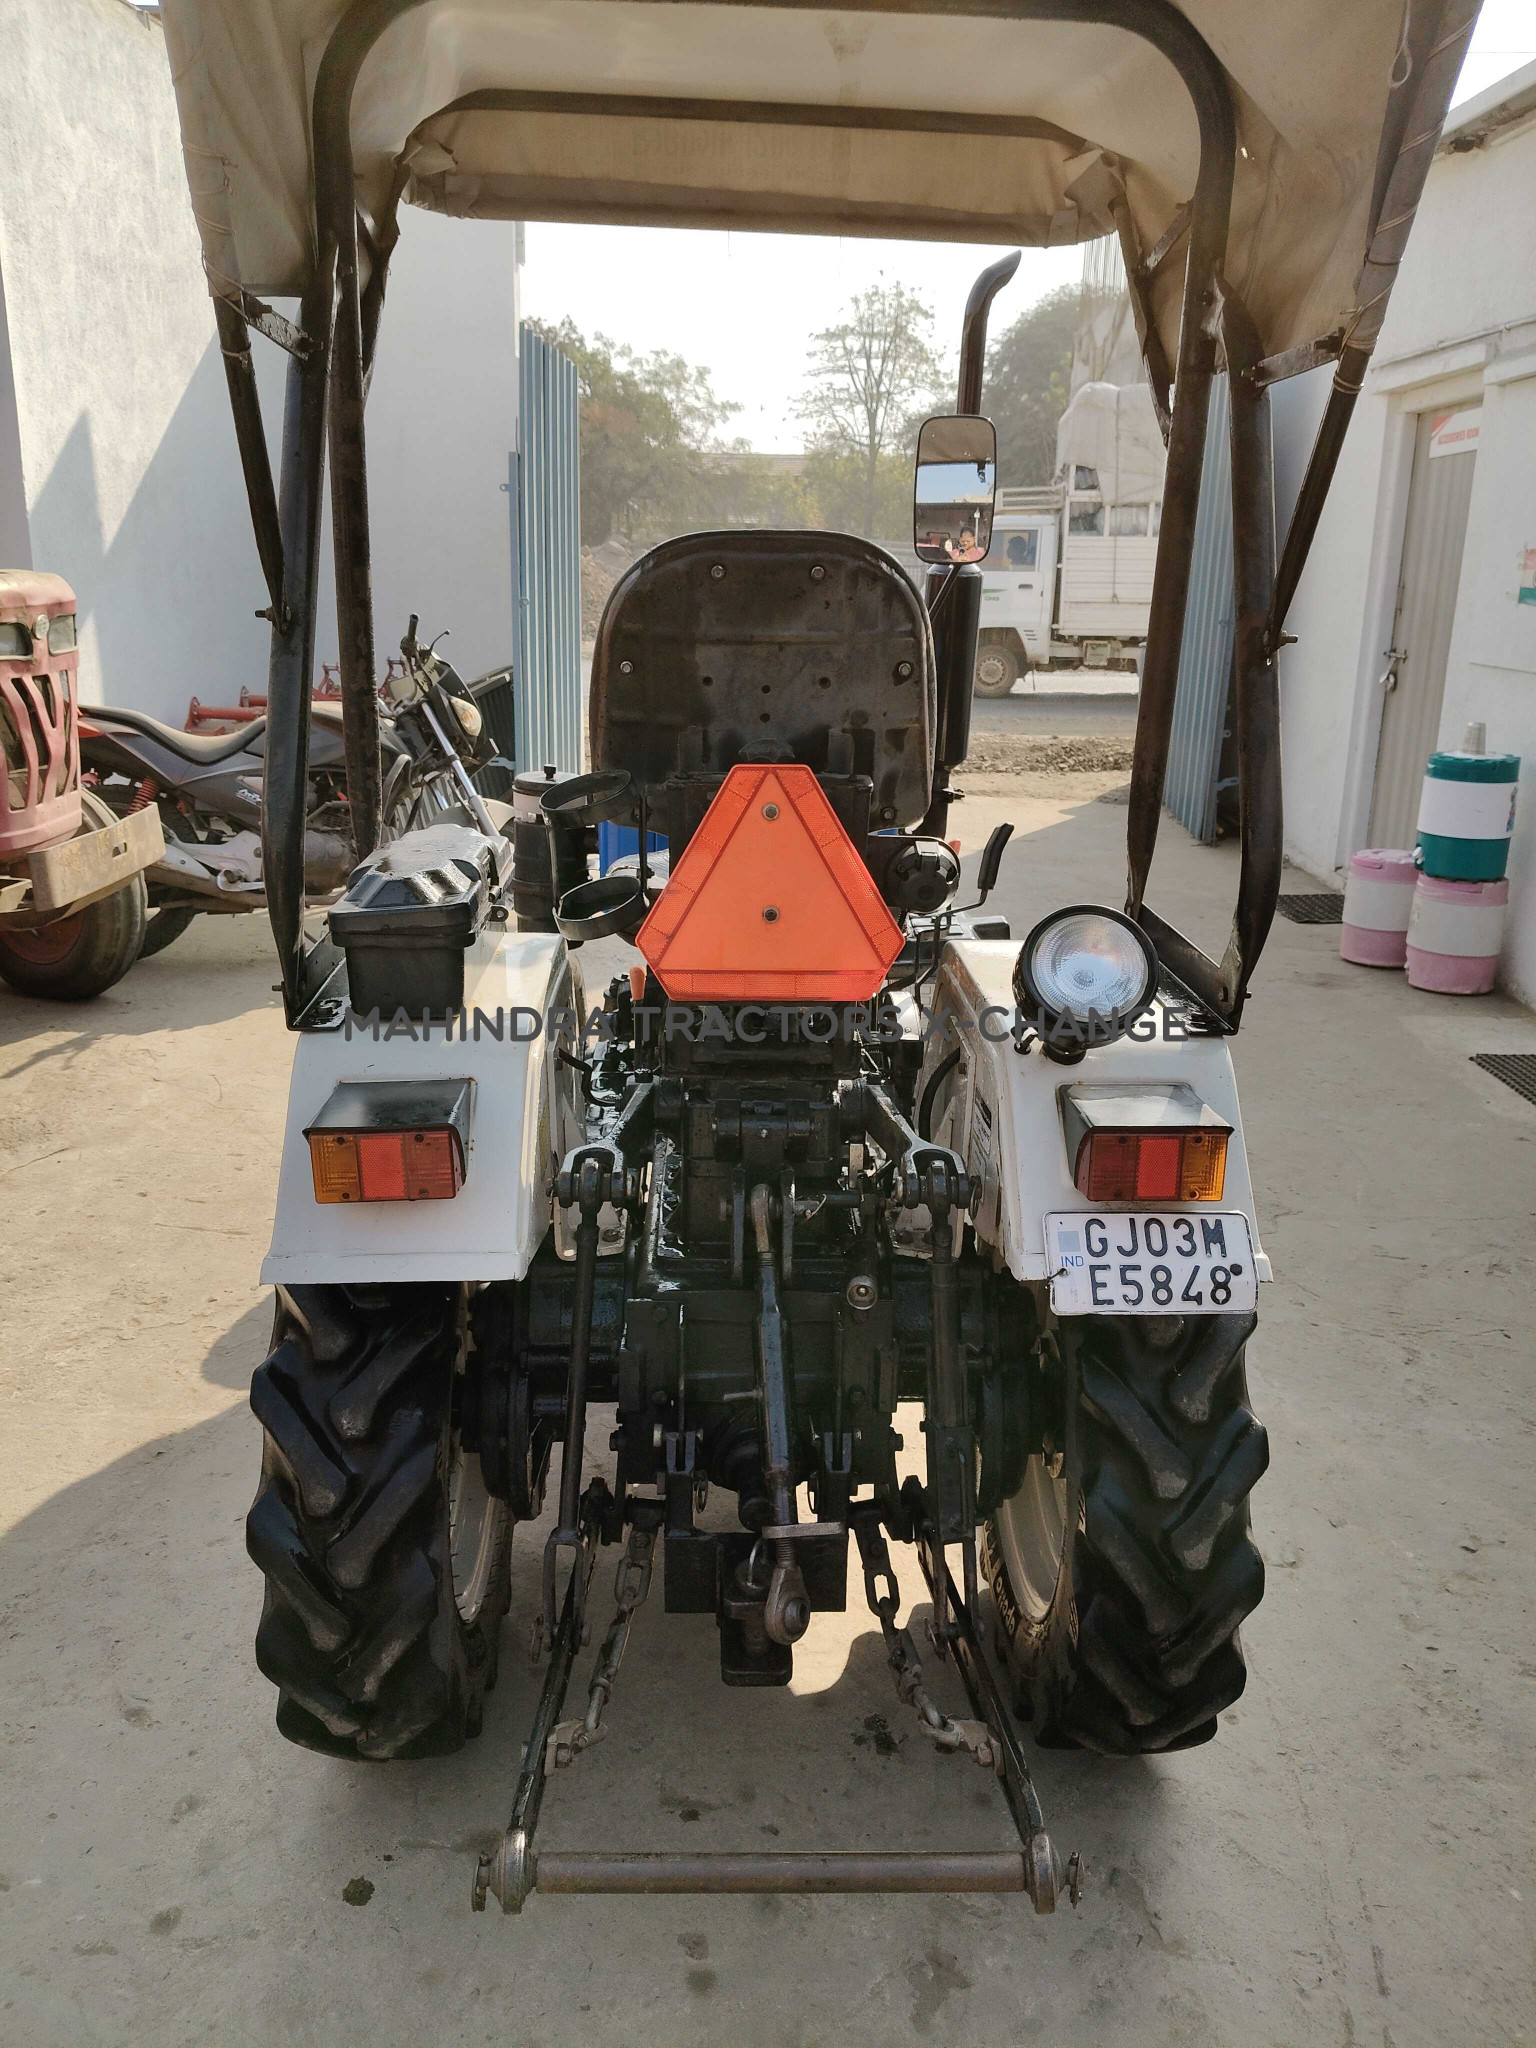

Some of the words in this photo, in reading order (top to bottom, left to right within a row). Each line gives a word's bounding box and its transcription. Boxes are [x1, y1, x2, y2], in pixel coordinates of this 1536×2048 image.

[1085, 1218, 1227, 1257] GJ03M
[1061, 1256, 1084, 1267] IND
[1089, 1265, 1232, 1305] E5848
